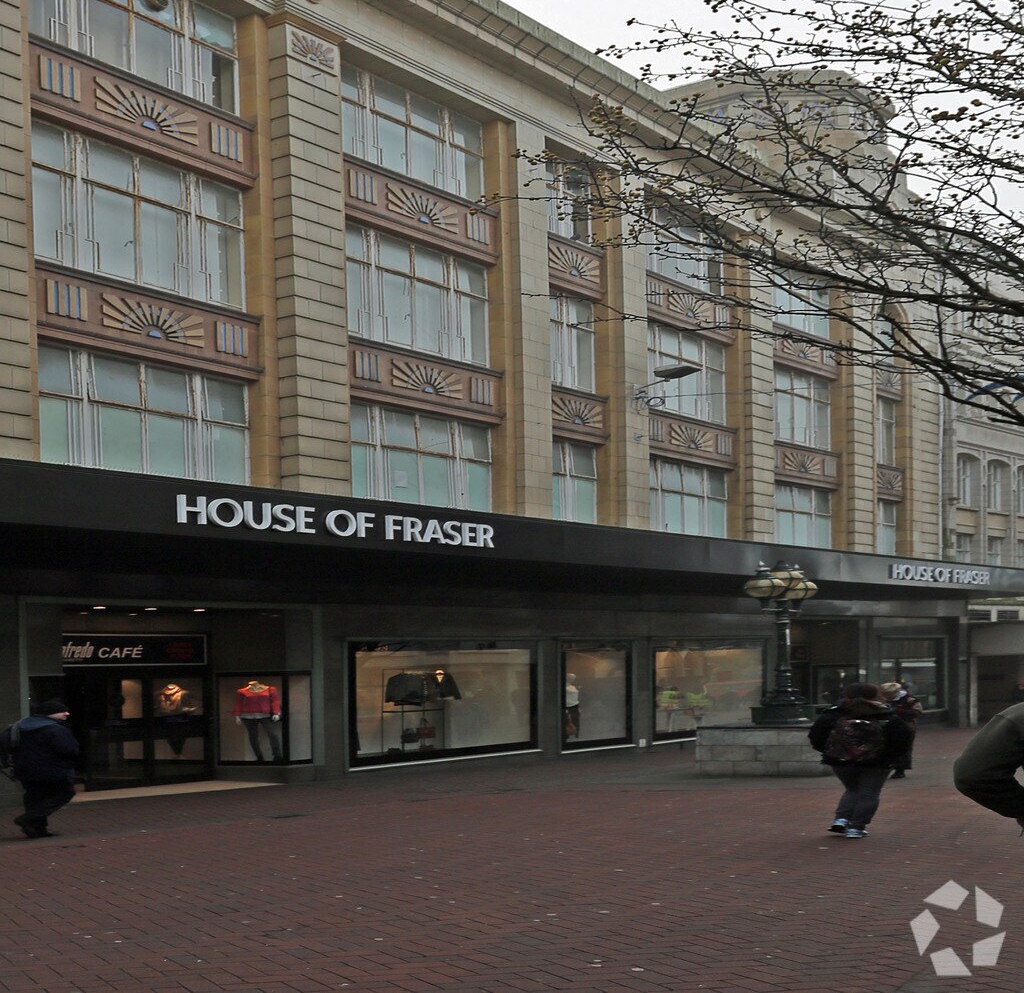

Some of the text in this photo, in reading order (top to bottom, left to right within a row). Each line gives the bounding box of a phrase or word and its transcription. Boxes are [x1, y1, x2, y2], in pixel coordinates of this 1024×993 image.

[176, 494, 494, 548] HOUSE OF FRASER
[891, 563, 990, 585] HOUSE OF FRASER
[98, 645, 143, 659] CAFÉ
